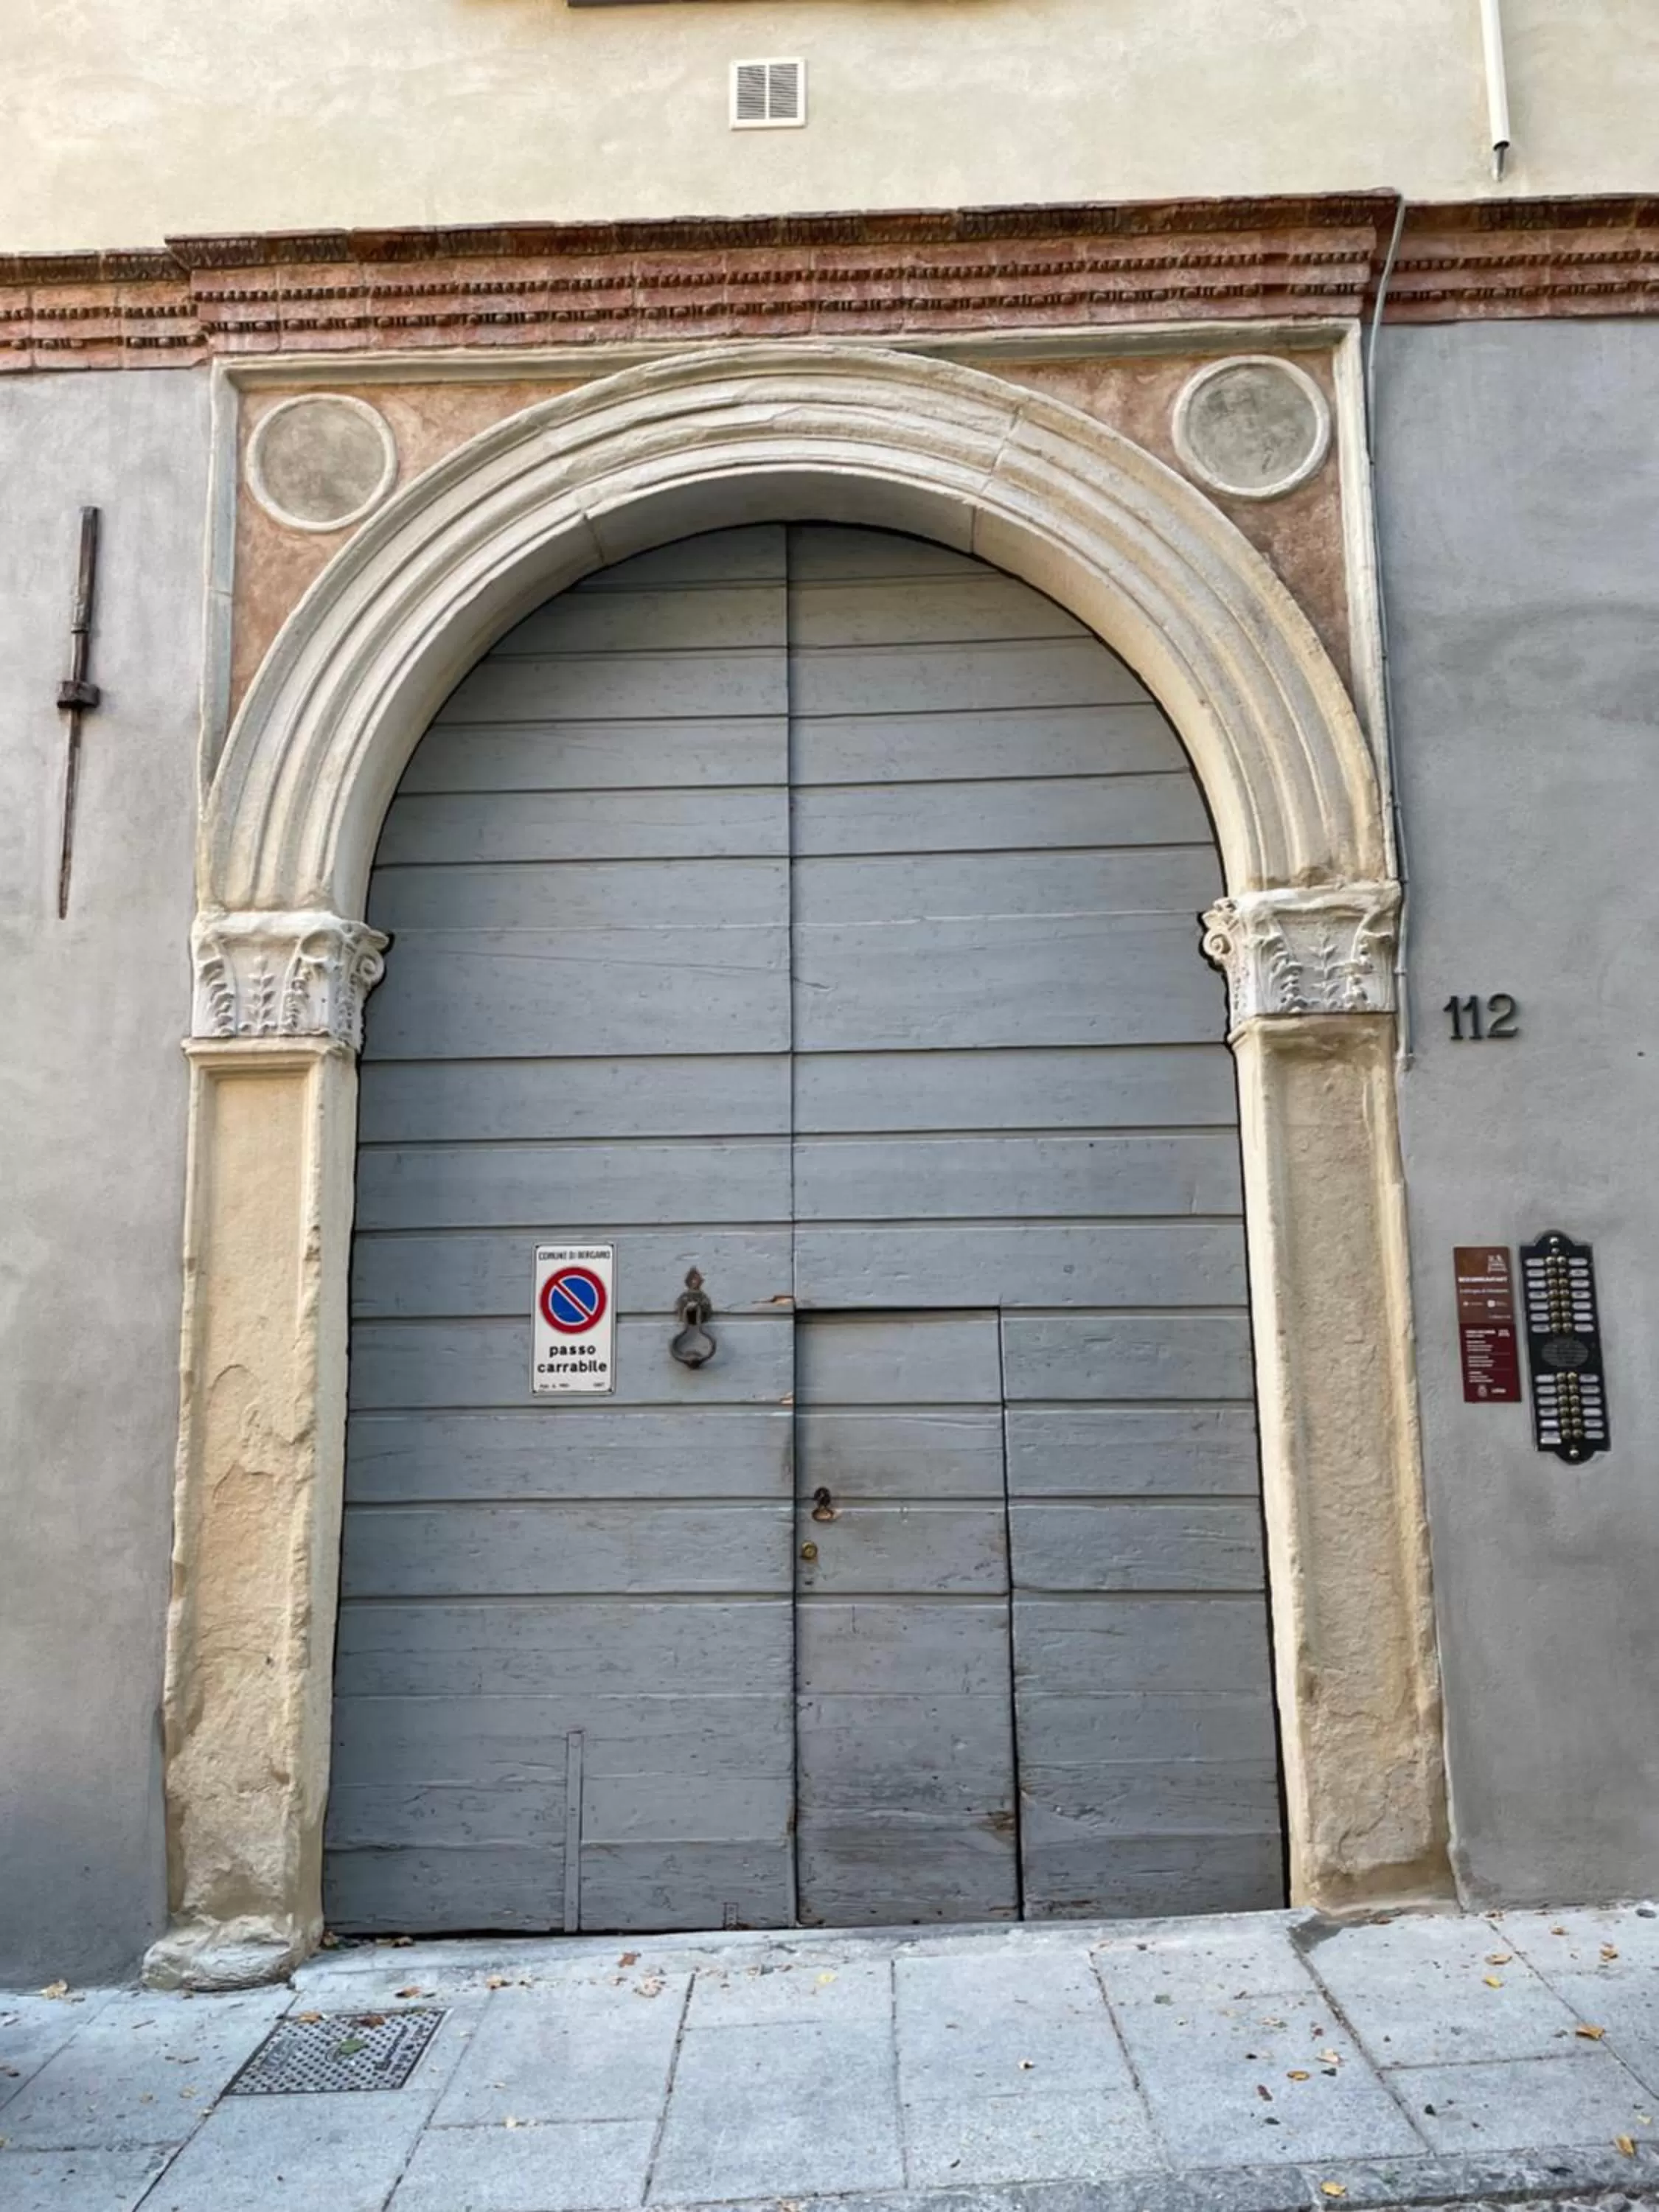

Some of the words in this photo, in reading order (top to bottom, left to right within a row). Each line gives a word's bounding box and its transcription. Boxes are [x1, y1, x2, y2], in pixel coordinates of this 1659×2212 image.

[1443, 993, 1519, 1040] 112
[538, 1251, 567, 1260] COMUNE
[569, 1251, 576, 1259] DI
[578, 1250, 611, 1259] BERGAMO
[549, 1345, 597, 1357] passo
[537, 1360, 607, 1373] carrabile
